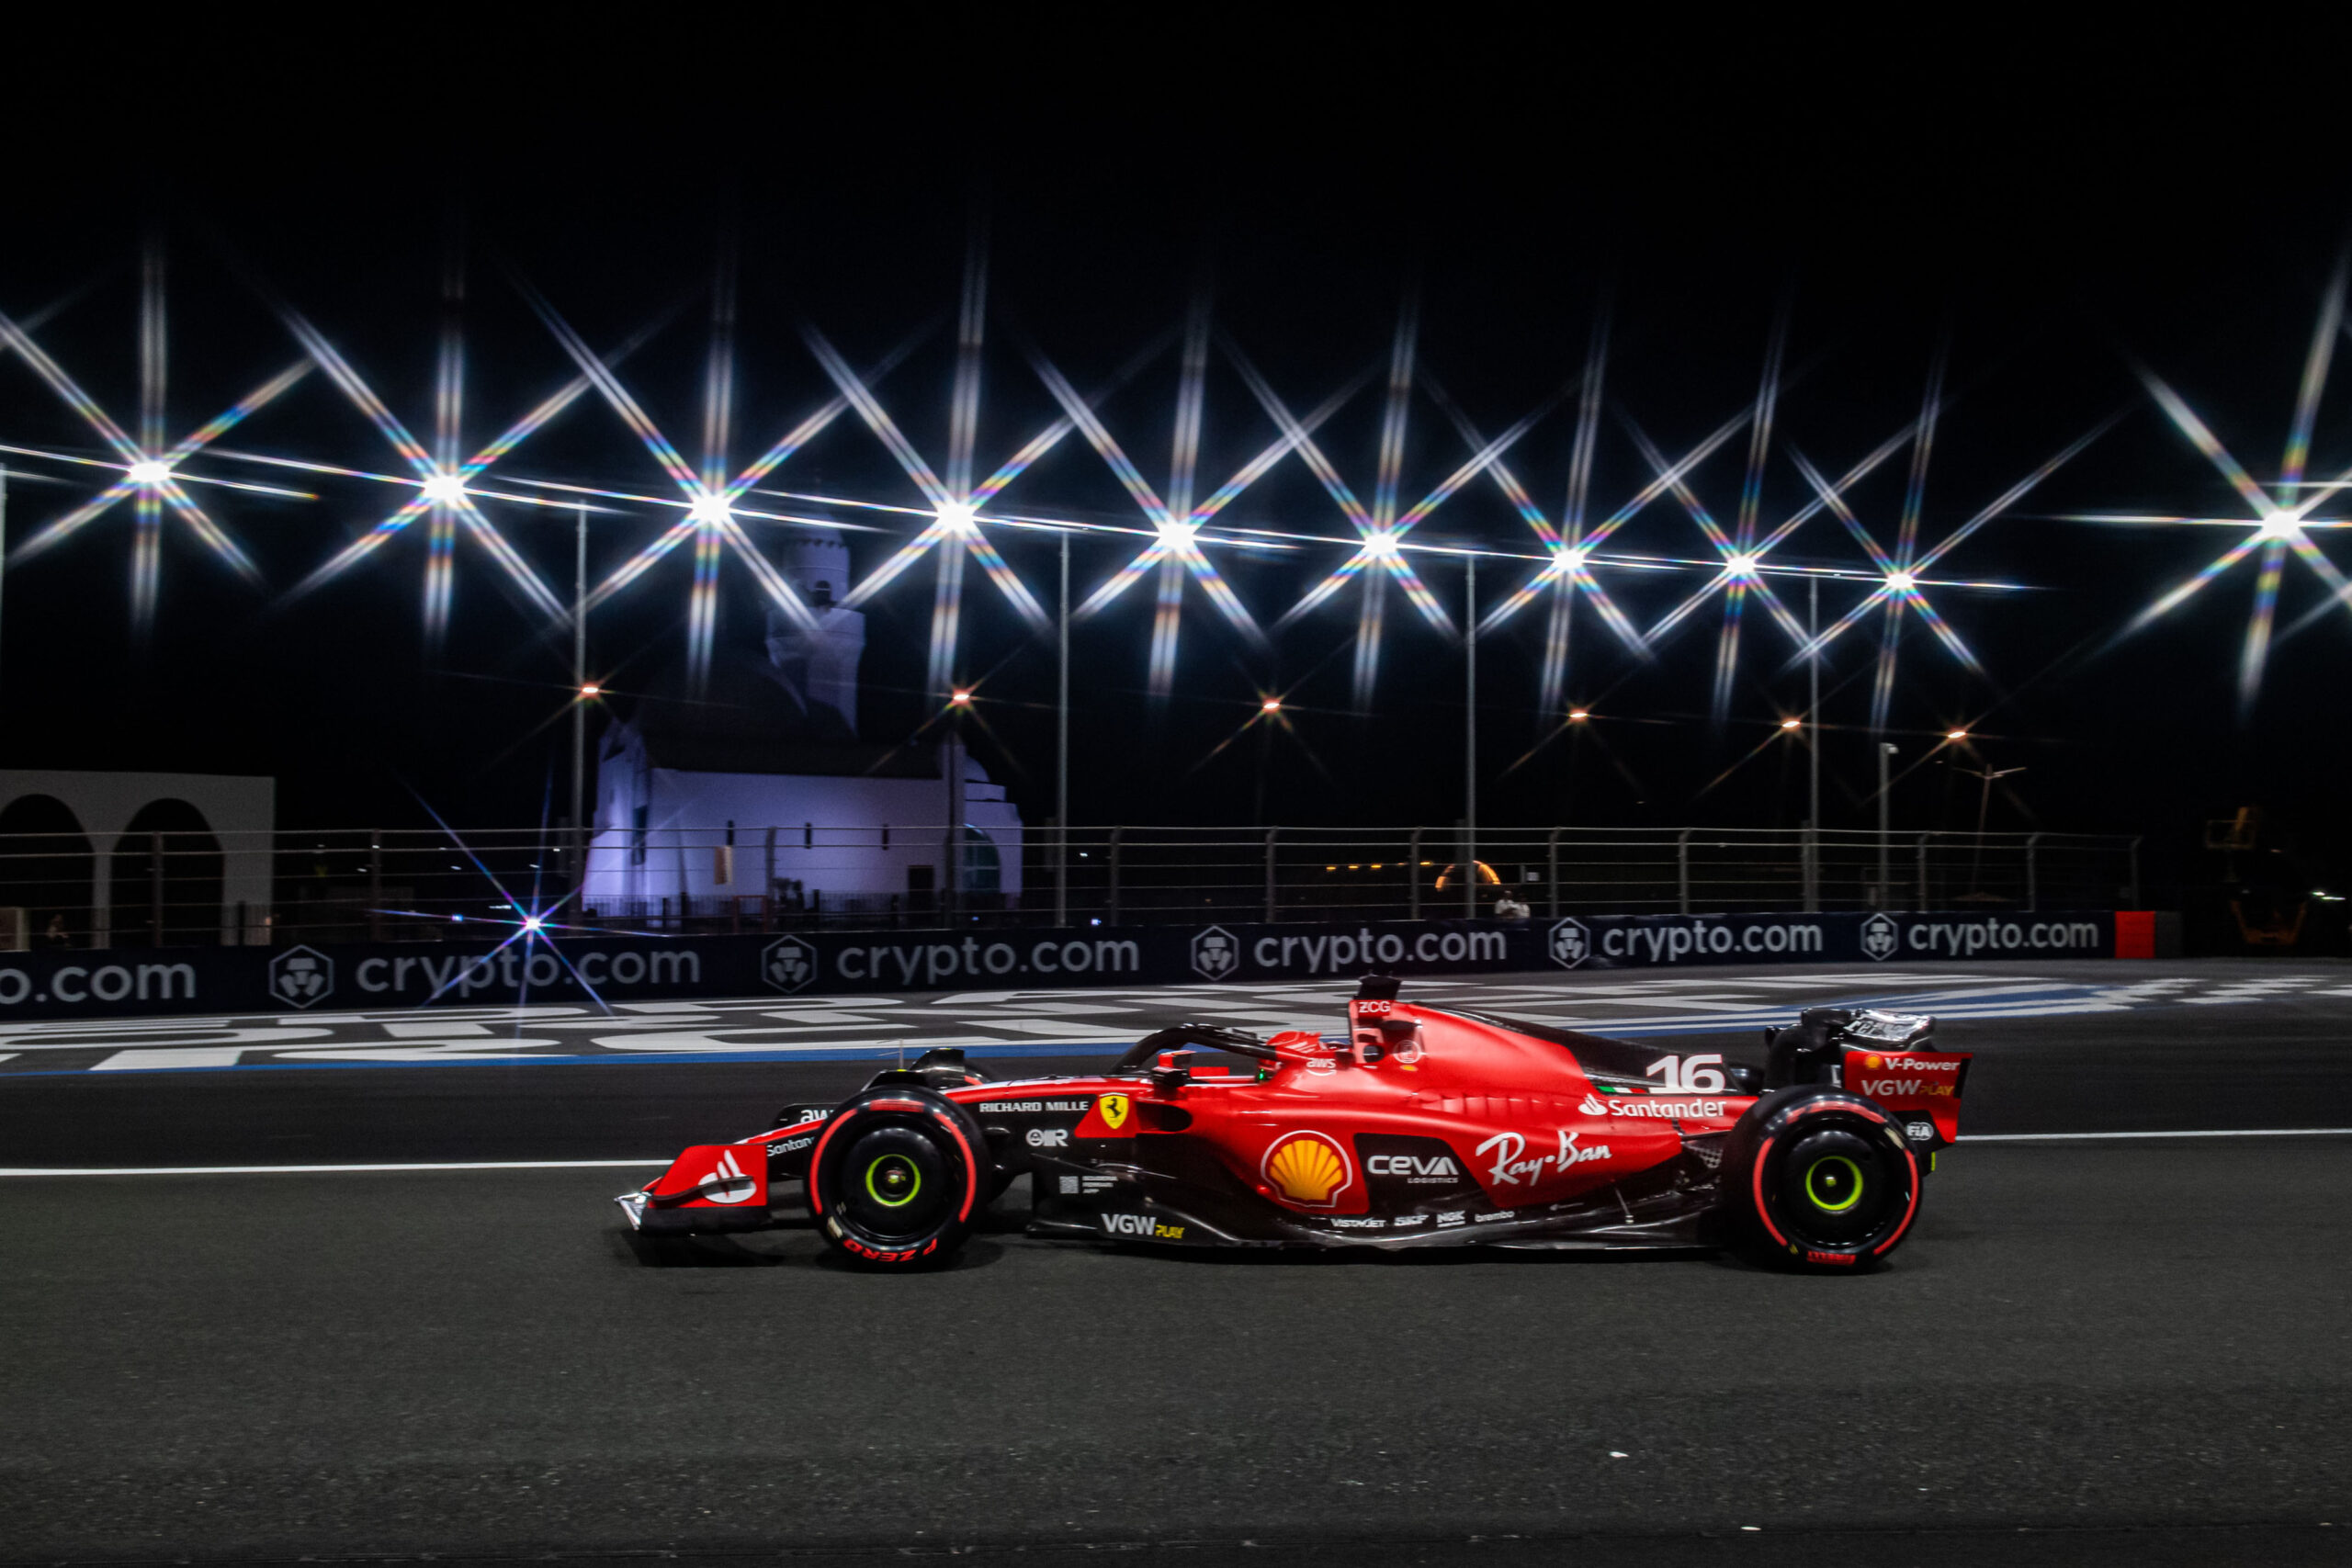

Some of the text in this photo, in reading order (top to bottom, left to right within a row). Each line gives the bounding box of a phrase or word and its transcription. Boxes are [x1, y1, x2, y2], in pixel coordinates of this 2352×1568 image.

[1602, 921, 1823, 963] crypto.com
[1907, 919, 2099, 958] crypto.com
[837, 937, 1140, 985] crypto.com
[1253, 928, 1508, 974] crypto.com
[356, 947, 701, 999] crypto.com
[1359, 1001, 1390, 1013] ZCG
[1306, 1058, 1336, 1068] aws
[1884, 1058, 1960, 1071] V-Power
[1646, 1054, 1725, 1094] 16
[1861, 1079, 1921, 1096] VGW
[800, 1110, 834, 1122] aw
[979, 1101, 1089, 1112] RICHARD MILLE
[1609, 1099, 1726, 1118] Santander
[767, 1137, 816, 1157] Santan
[1101, 1213, 1157, 1235] VGW
[1475, 1211, 1515, 1223] brembo
[842, 1238, 917, 1262] ZERO
